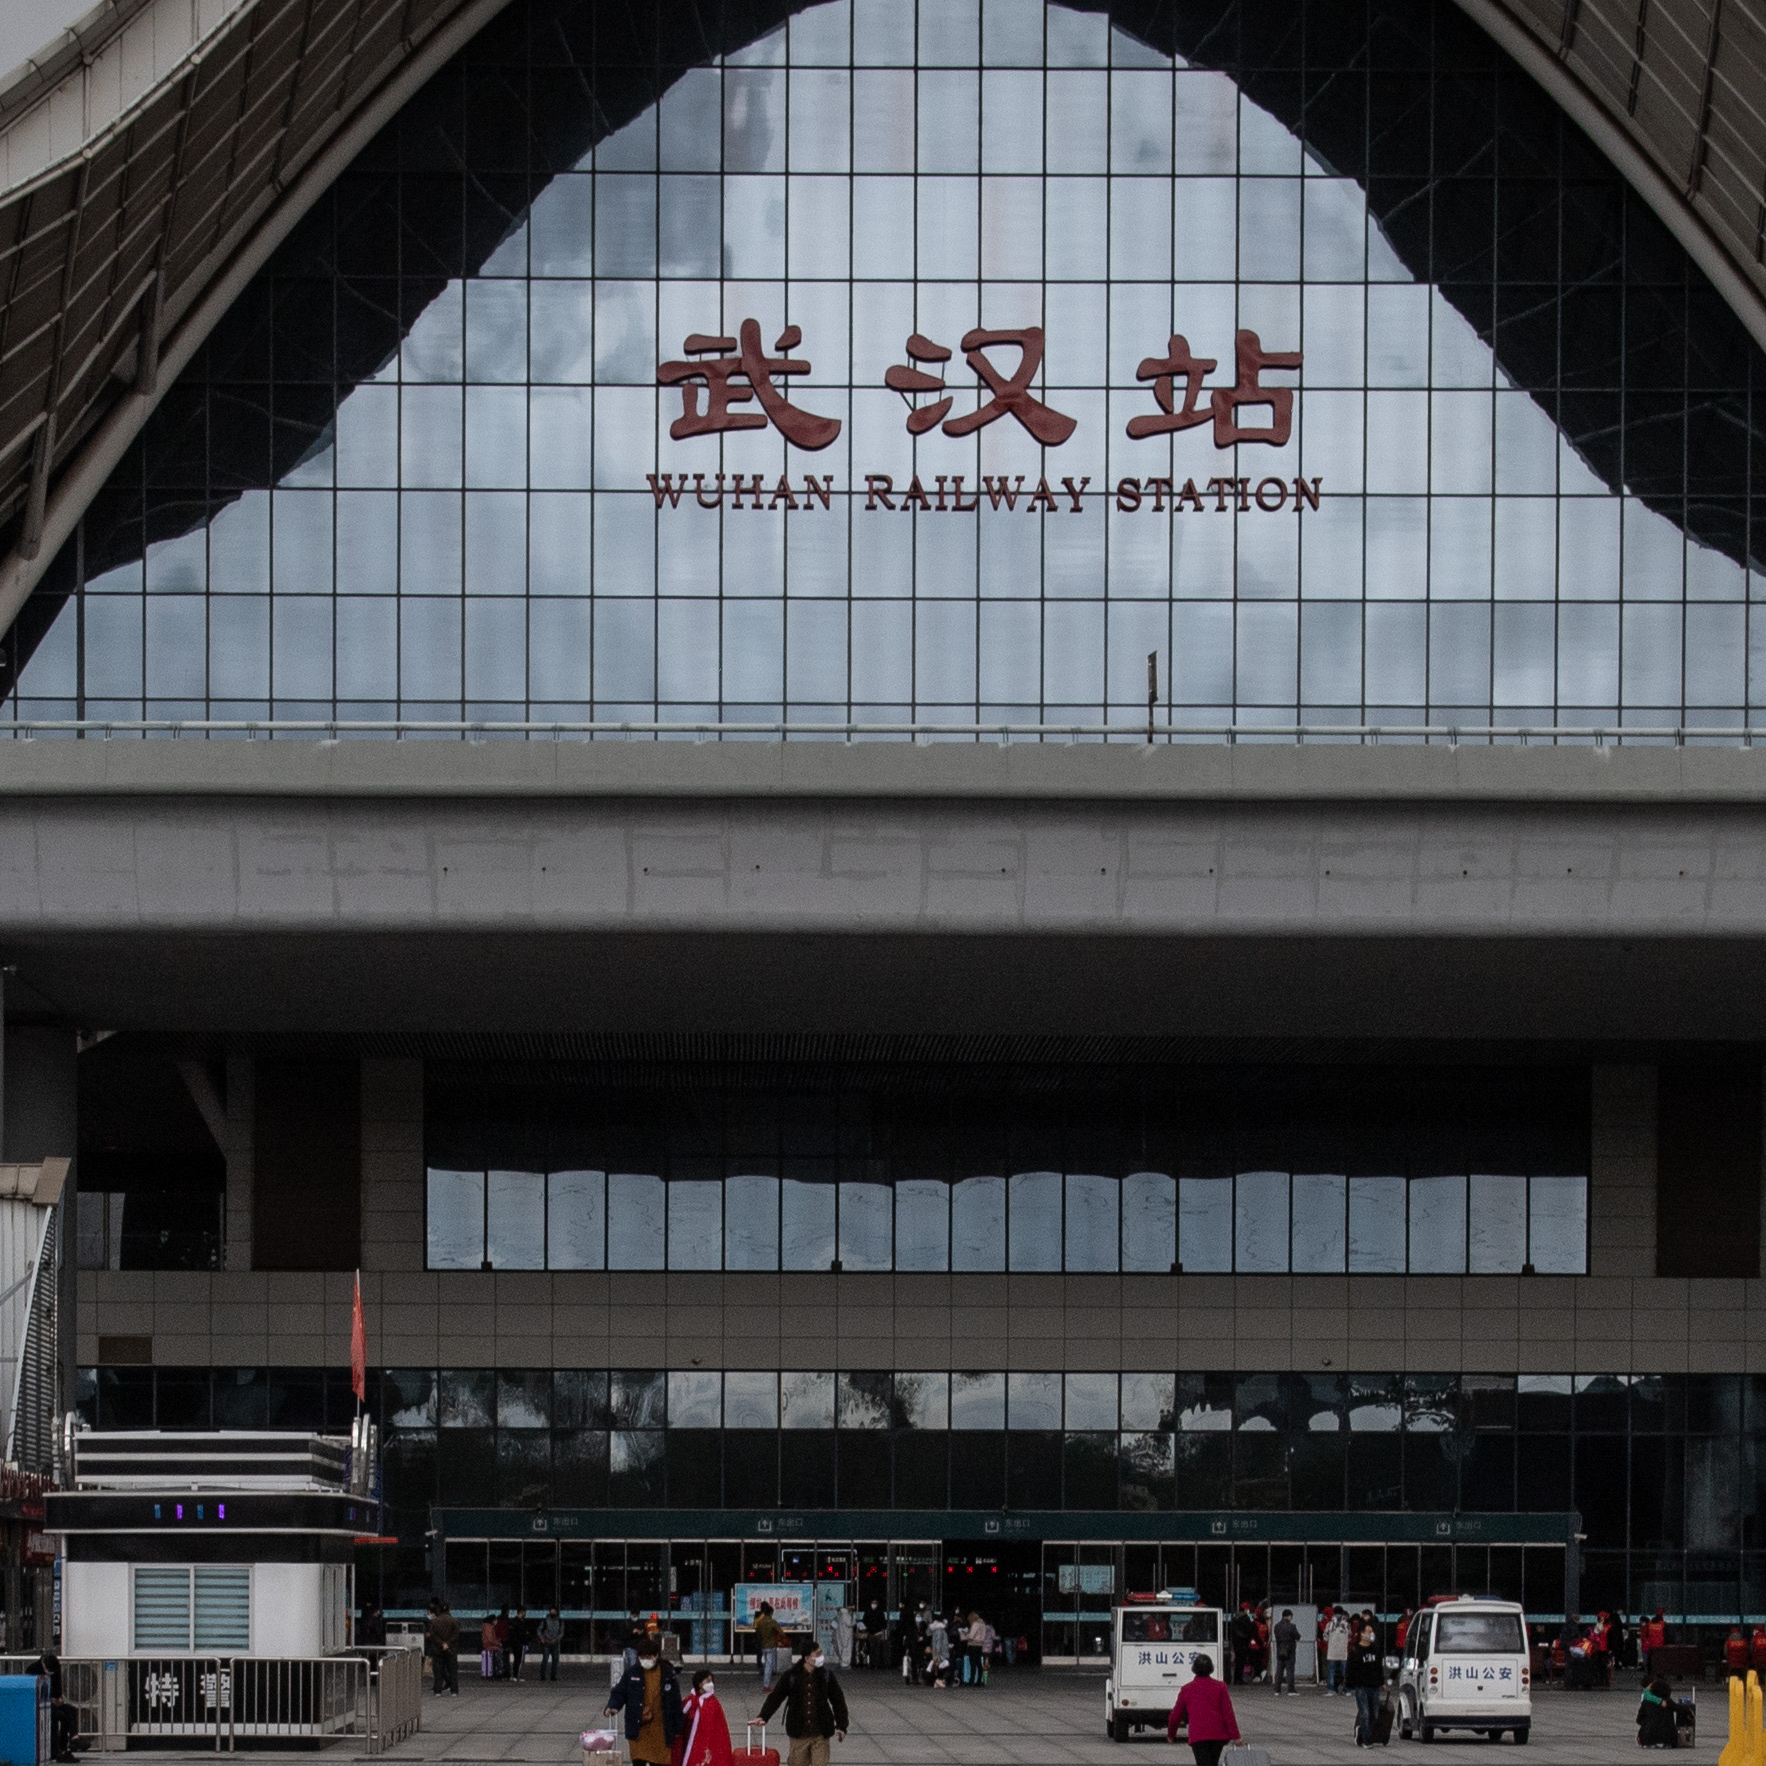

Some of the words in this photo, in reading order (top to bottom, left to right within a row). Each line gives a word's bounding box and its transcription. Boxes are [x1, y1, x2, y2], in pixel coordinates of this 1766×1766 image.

[656, 318, 1304, 451] 武汉站
[646, 472, 835, 512] WUHAN
[864, 474, 1092, 513] RAILWAY
[1116, 476, 1325, 513] STATION
[1138, 1651, 1200, 1666] 洪山公安
[1449, 1666, 1512, 1680] 洪山公安
[144, 1671, 231, 1709] 特警
